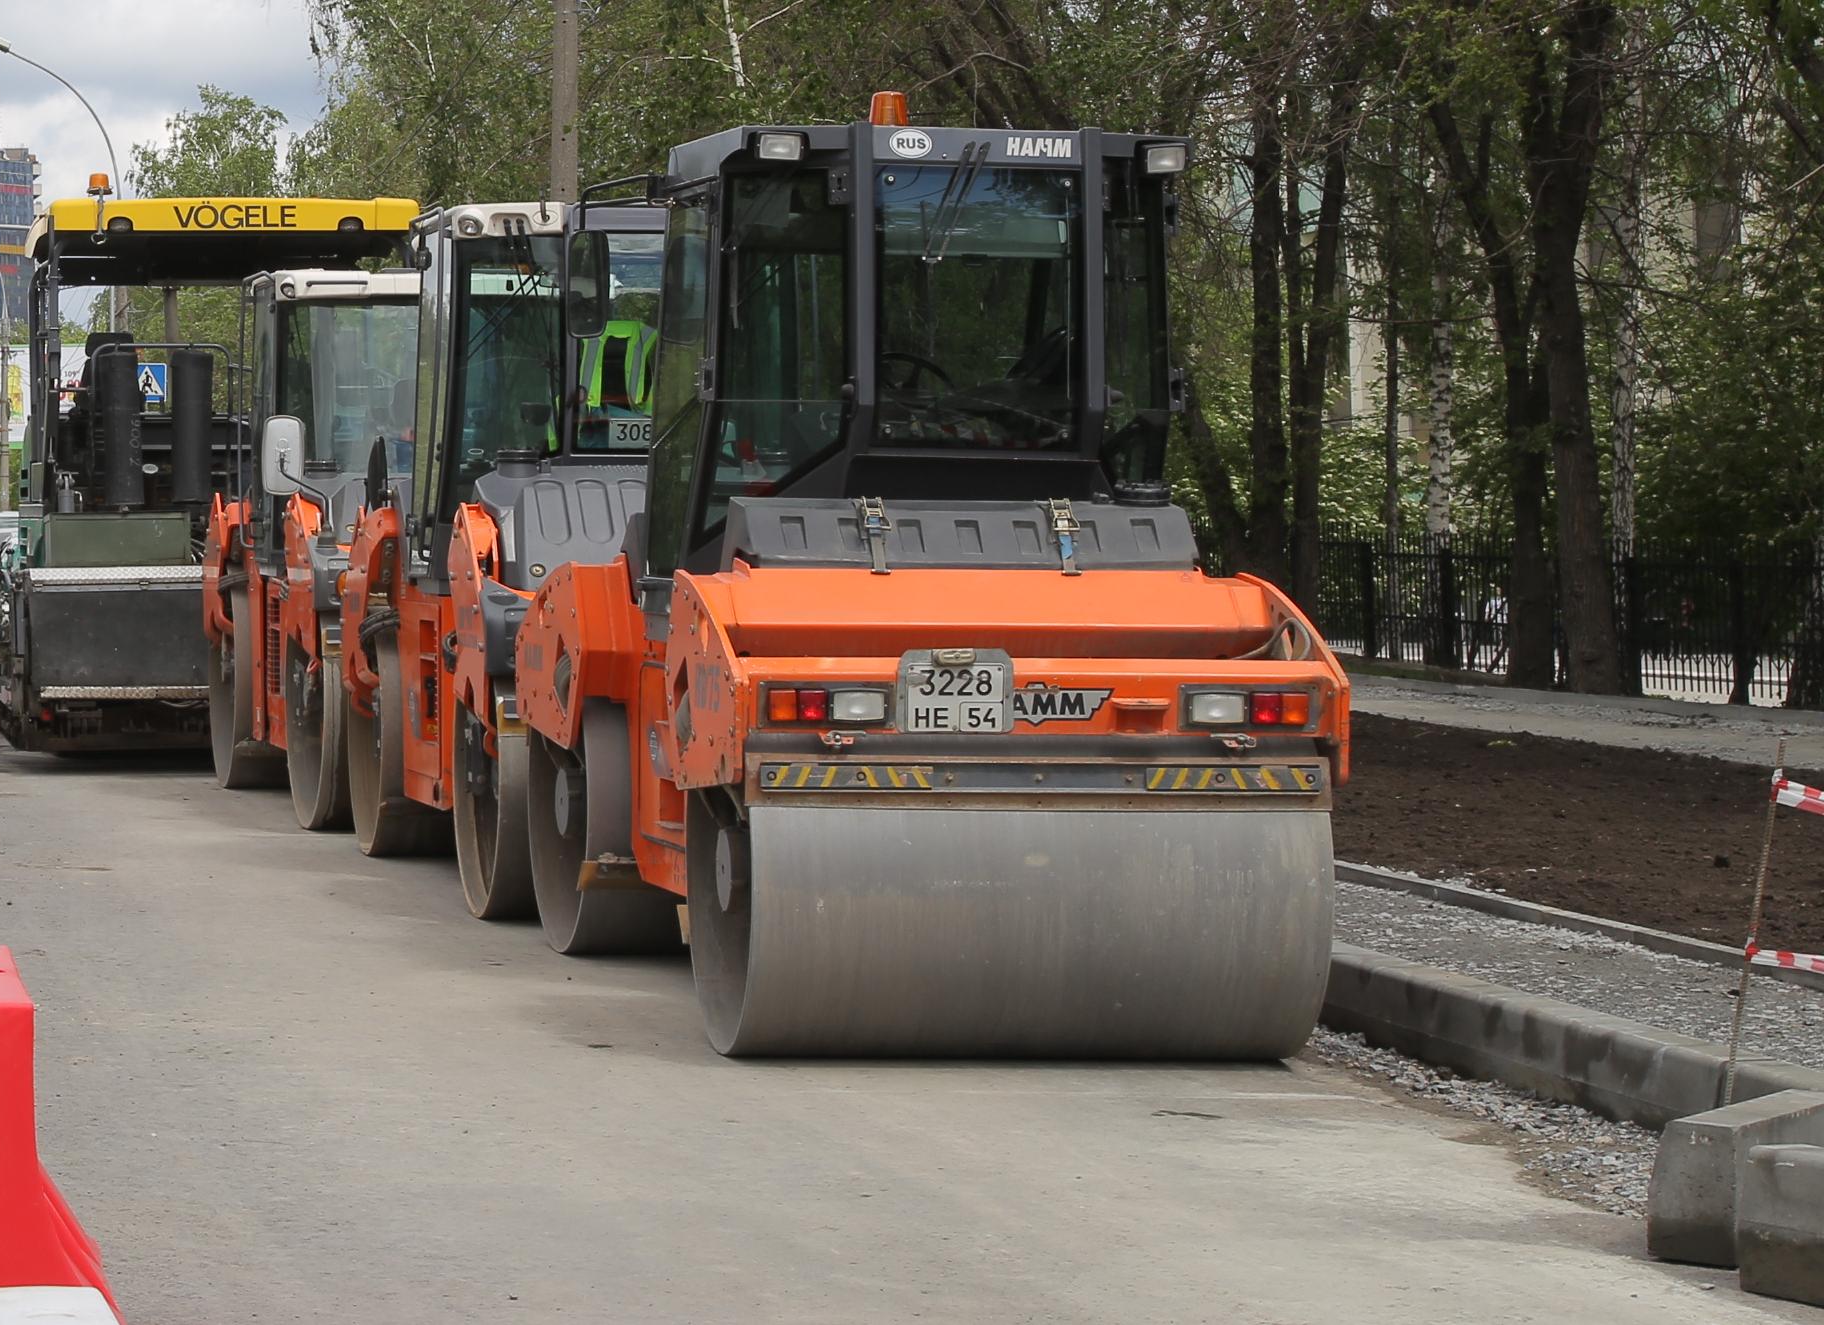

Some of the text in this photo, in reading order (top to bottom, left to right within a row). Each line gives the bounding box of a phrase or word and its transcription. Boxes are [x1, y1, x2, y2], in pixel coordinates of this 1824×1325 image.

[895, 137, 926, 150] RUS
[1006, 136, 1072, 158] HAMM
[173, 200, 297, 229] VÖGELE
[919, 669, 993, 697] 3228
[1013, 692, 1086, 716] AMM
[967, 707, 997, 729] 54
